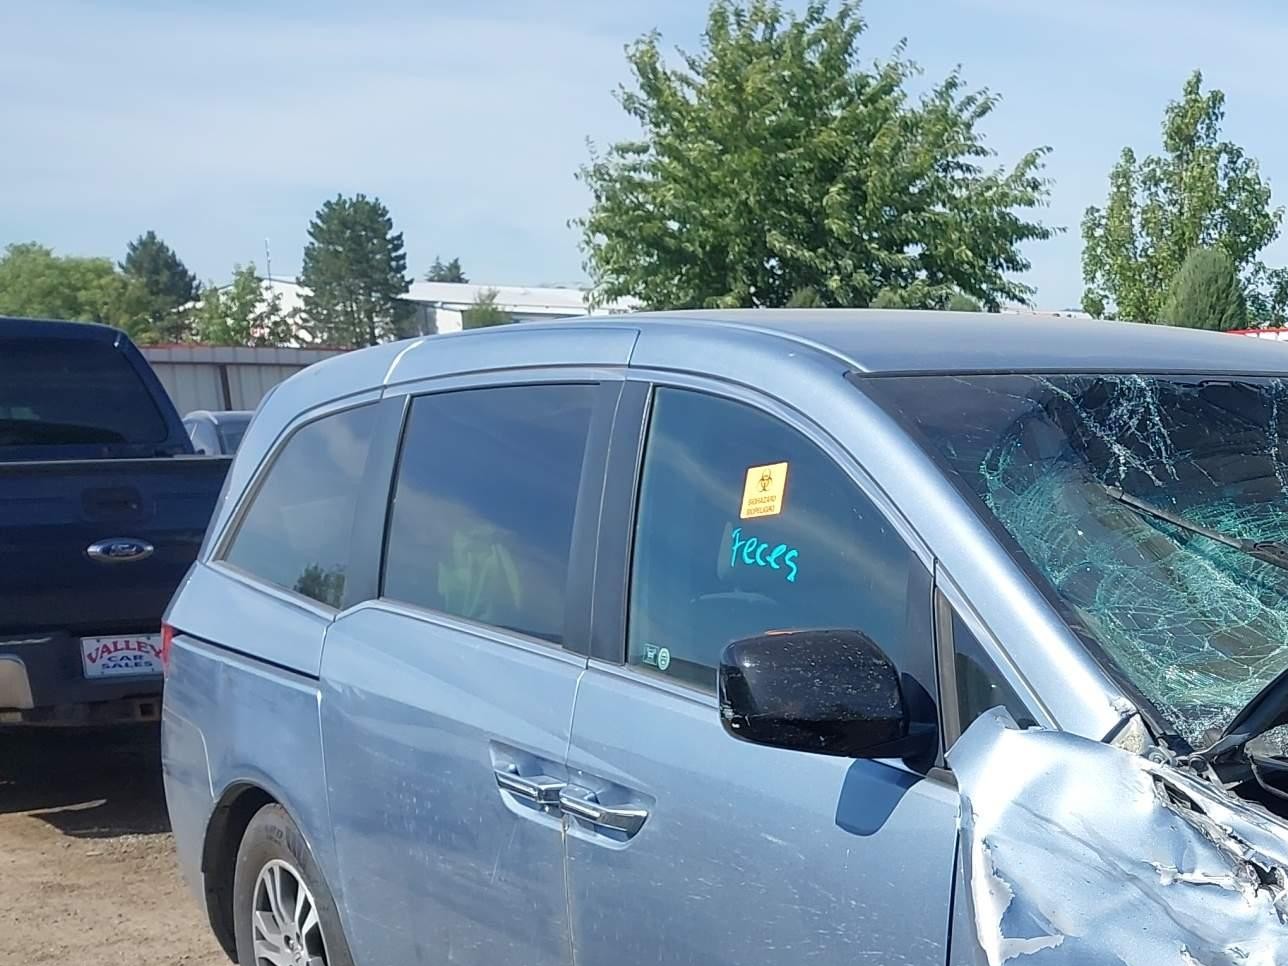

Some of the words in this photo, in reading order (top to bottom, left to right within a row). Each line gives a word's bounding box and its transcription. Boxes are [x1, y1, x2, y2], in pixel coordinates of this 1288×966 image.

[86, 639, 162, 664] VALLEY
[107, 655, 144, 663] CAR
[101, 661, 153, 670] SALES
